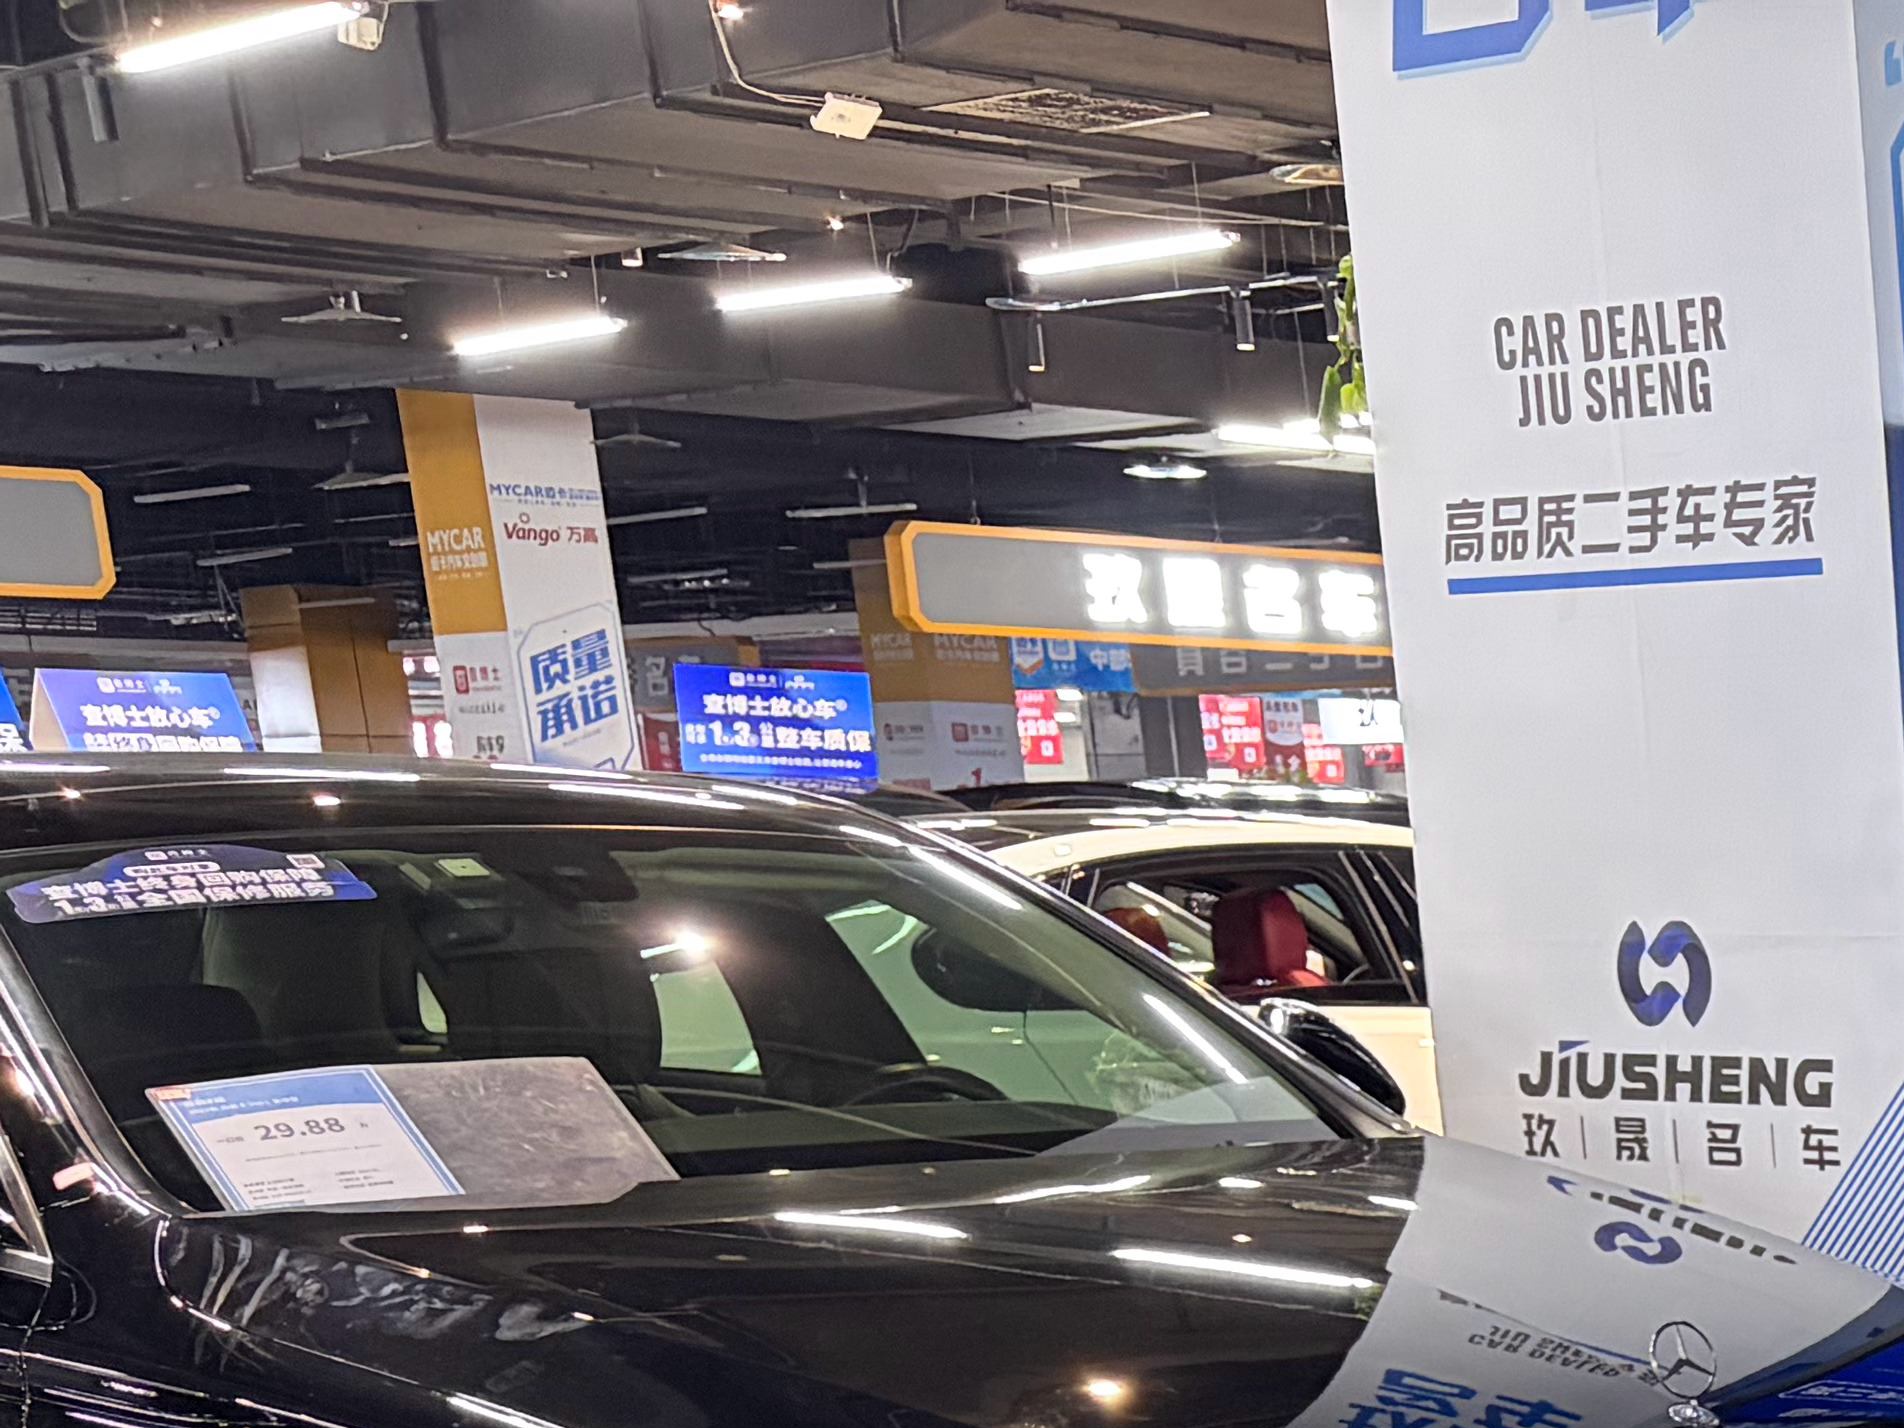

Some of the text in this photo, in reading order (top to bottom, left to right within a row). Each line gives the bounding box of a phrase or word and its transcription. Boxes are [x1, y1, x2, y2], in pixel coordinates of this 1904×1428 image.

[1493, 296, 1726, 370] CAR DEALER
[1519, 358, 1713, 428] JIU SHENG
[427, 527, 485, 553] MYCAR
[504, 522, 560, 547] Vango
[1445, 474, 1817, 566] 高品质二手车专家
[530, 629, 613, 695] 质量
[536, 675, 619, 743] 承诺
[254, 1117, 346, 1142] 29.88
